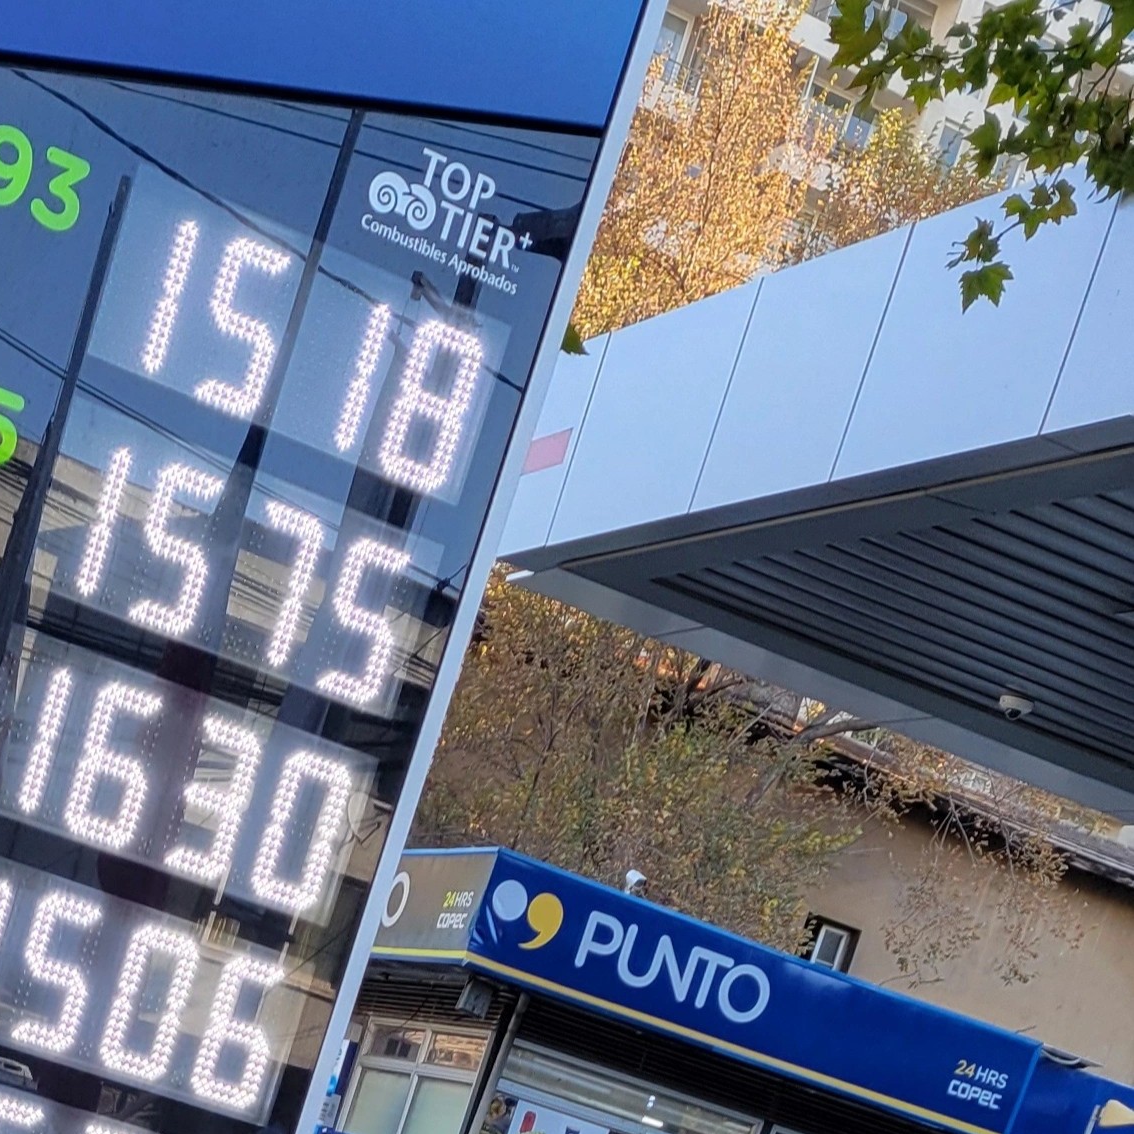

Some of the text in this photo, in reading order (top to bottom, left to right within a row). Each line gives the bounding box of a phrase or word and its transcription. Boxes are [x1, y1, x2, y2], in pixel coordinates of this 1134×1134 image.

[361, 213, 518, 295] Combustibles Aprobados
[423, 147, 496, 209] TOP
[141, 219, 483, 492] 1518
[75, 447, 411, 703] 1575
[19, 669, 352, 910] 1630
[574, 910, 771, 1024] PUNTO
